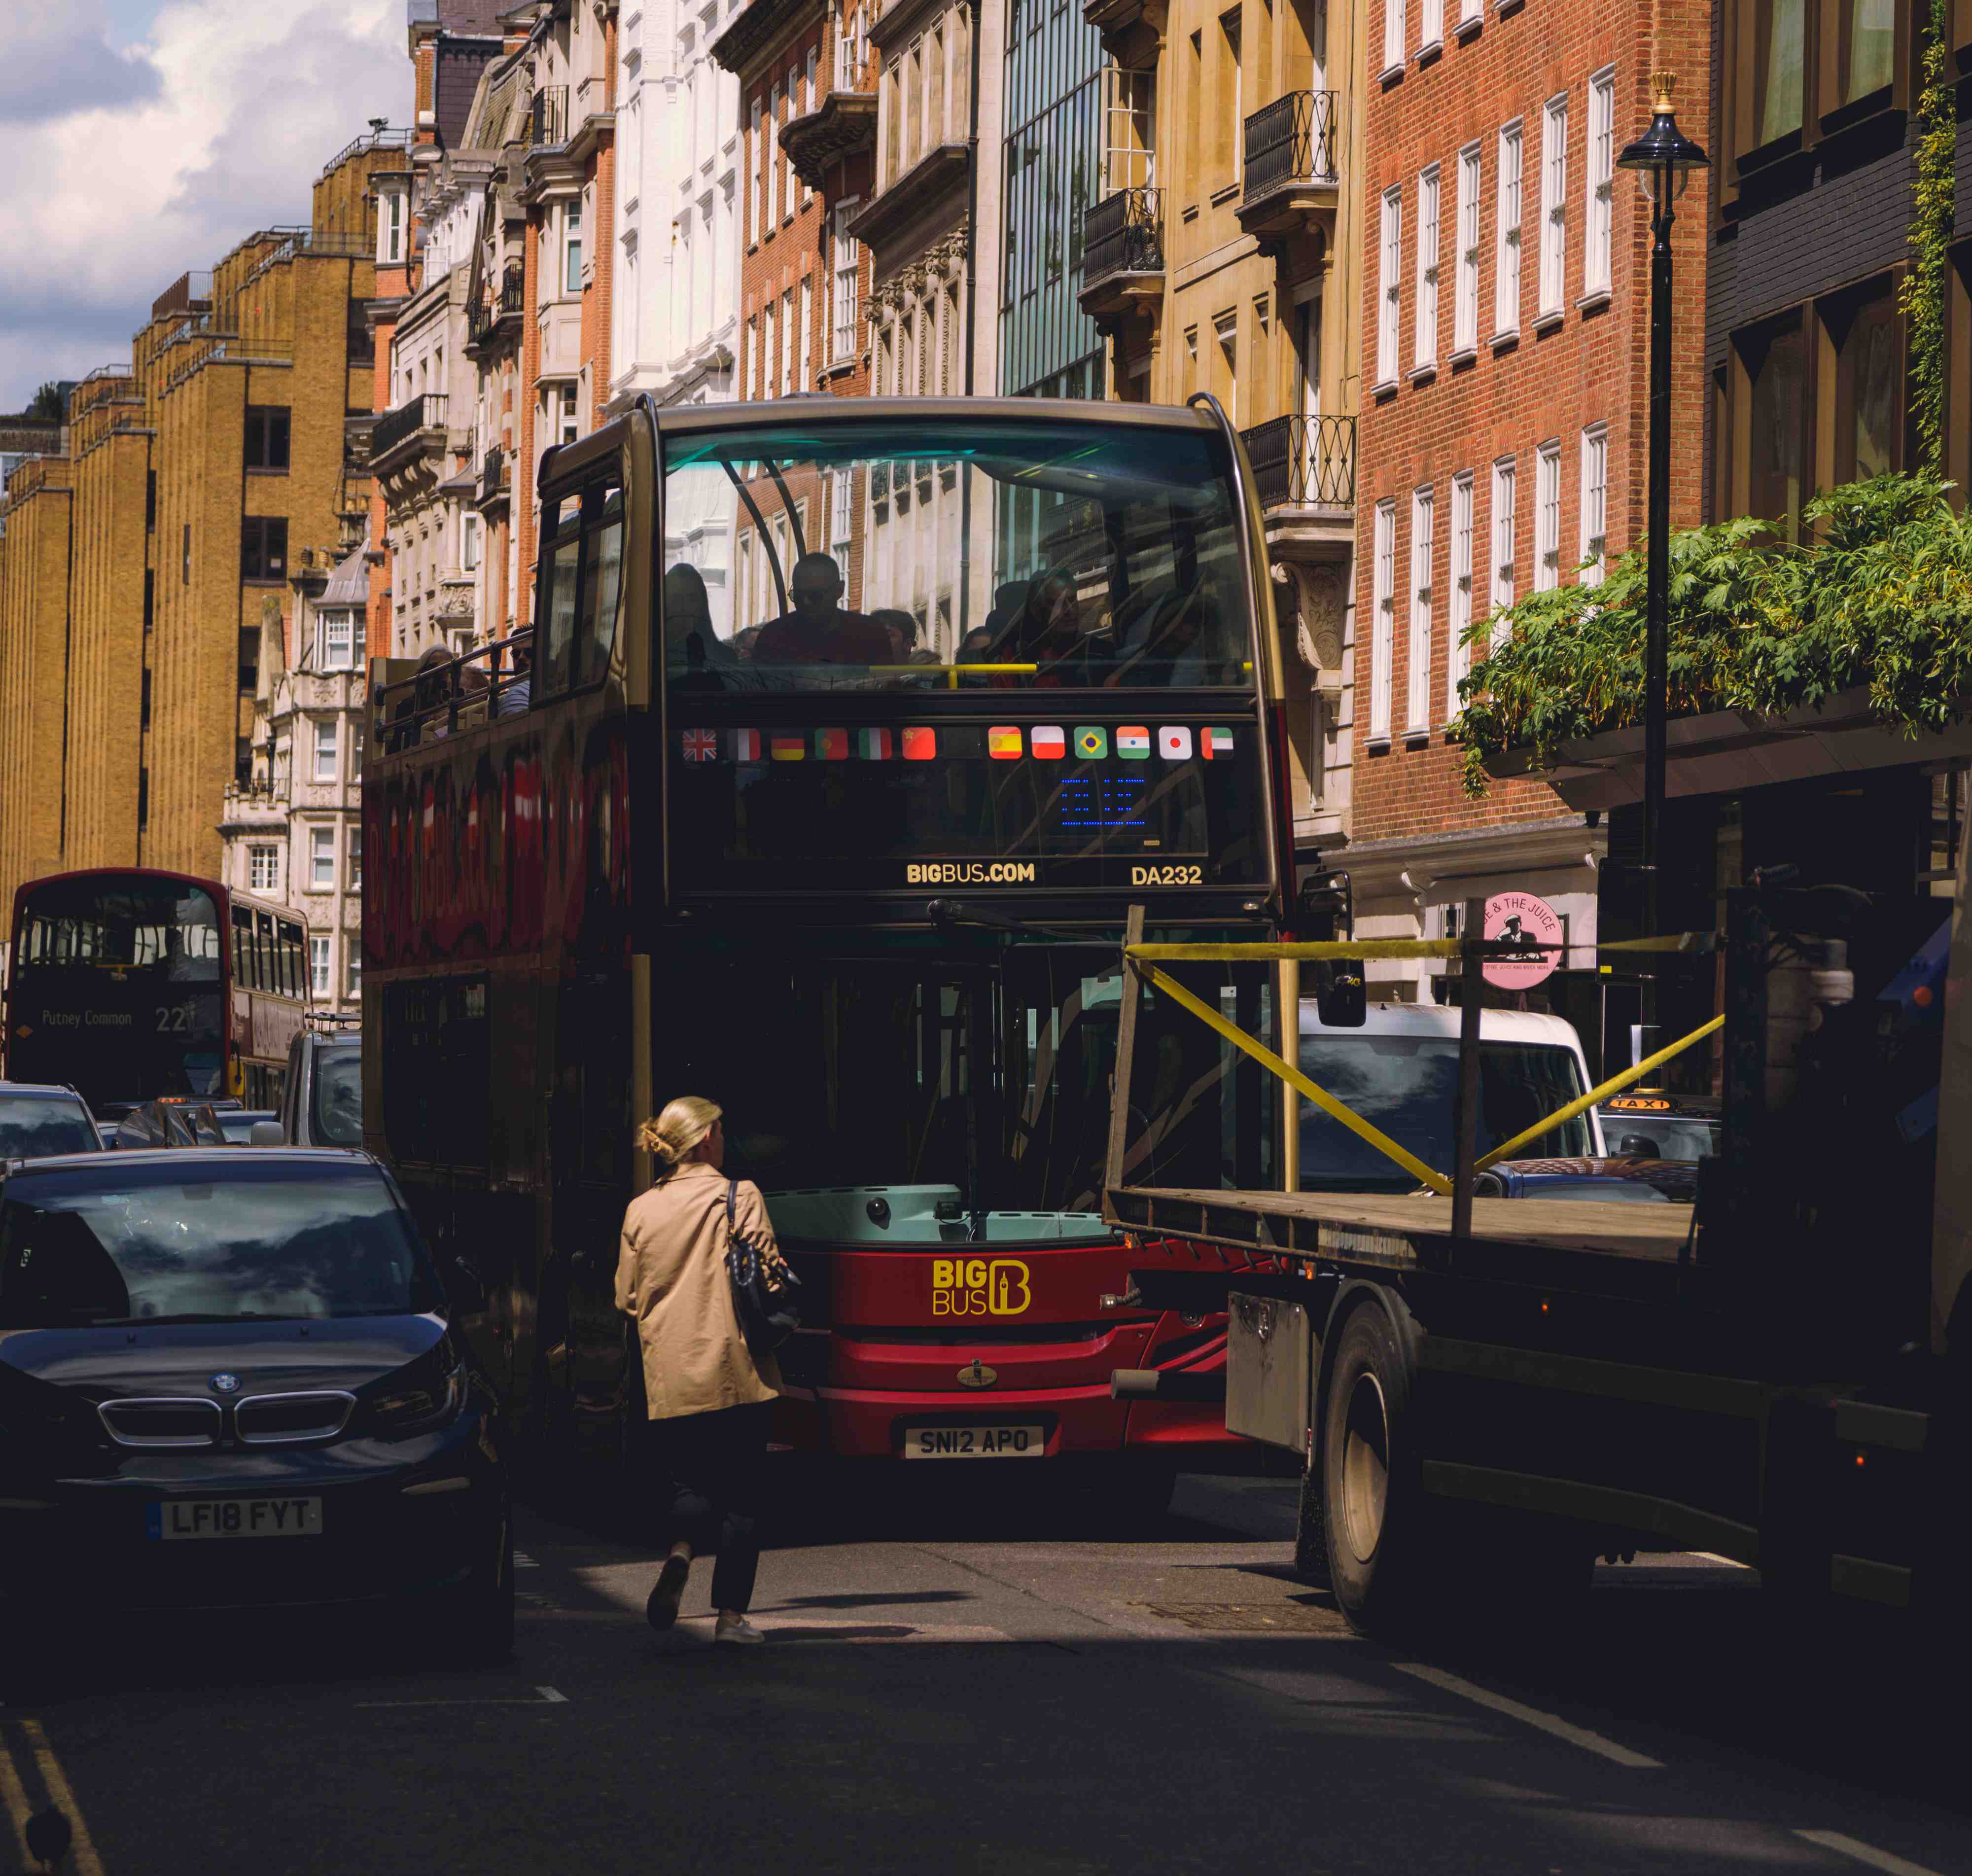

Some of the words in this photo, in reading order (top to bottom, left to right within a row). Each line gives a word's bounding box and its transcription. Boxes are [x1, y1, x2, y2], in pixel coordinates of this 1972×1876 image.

[907, 863, 1035, 883] BIGBUS.COM
[1131, 865, 1203, 885] DA232
[1492, 902, 1502, 913] &
[1504, 898, 1527, 910] THE
[1528, 904, 1556, 932] JUICE
[43, 1009, 81, 1029] Putney
[85, 1009, 132, 1026] Common
[155, 1006, 186, 1031] 22
[1617, 1099, 1664, 1108] TAXI
[933, 1259, 987, 1288] BIG
[933, 1289, 986, 1316] BUS
[920, 1430, 974, 1453] SN12
[982, 1430, 1028, 1452] APO
[173, 1503, 241, 1533] LF18
[250, 1500, 310, 1530] FYT
